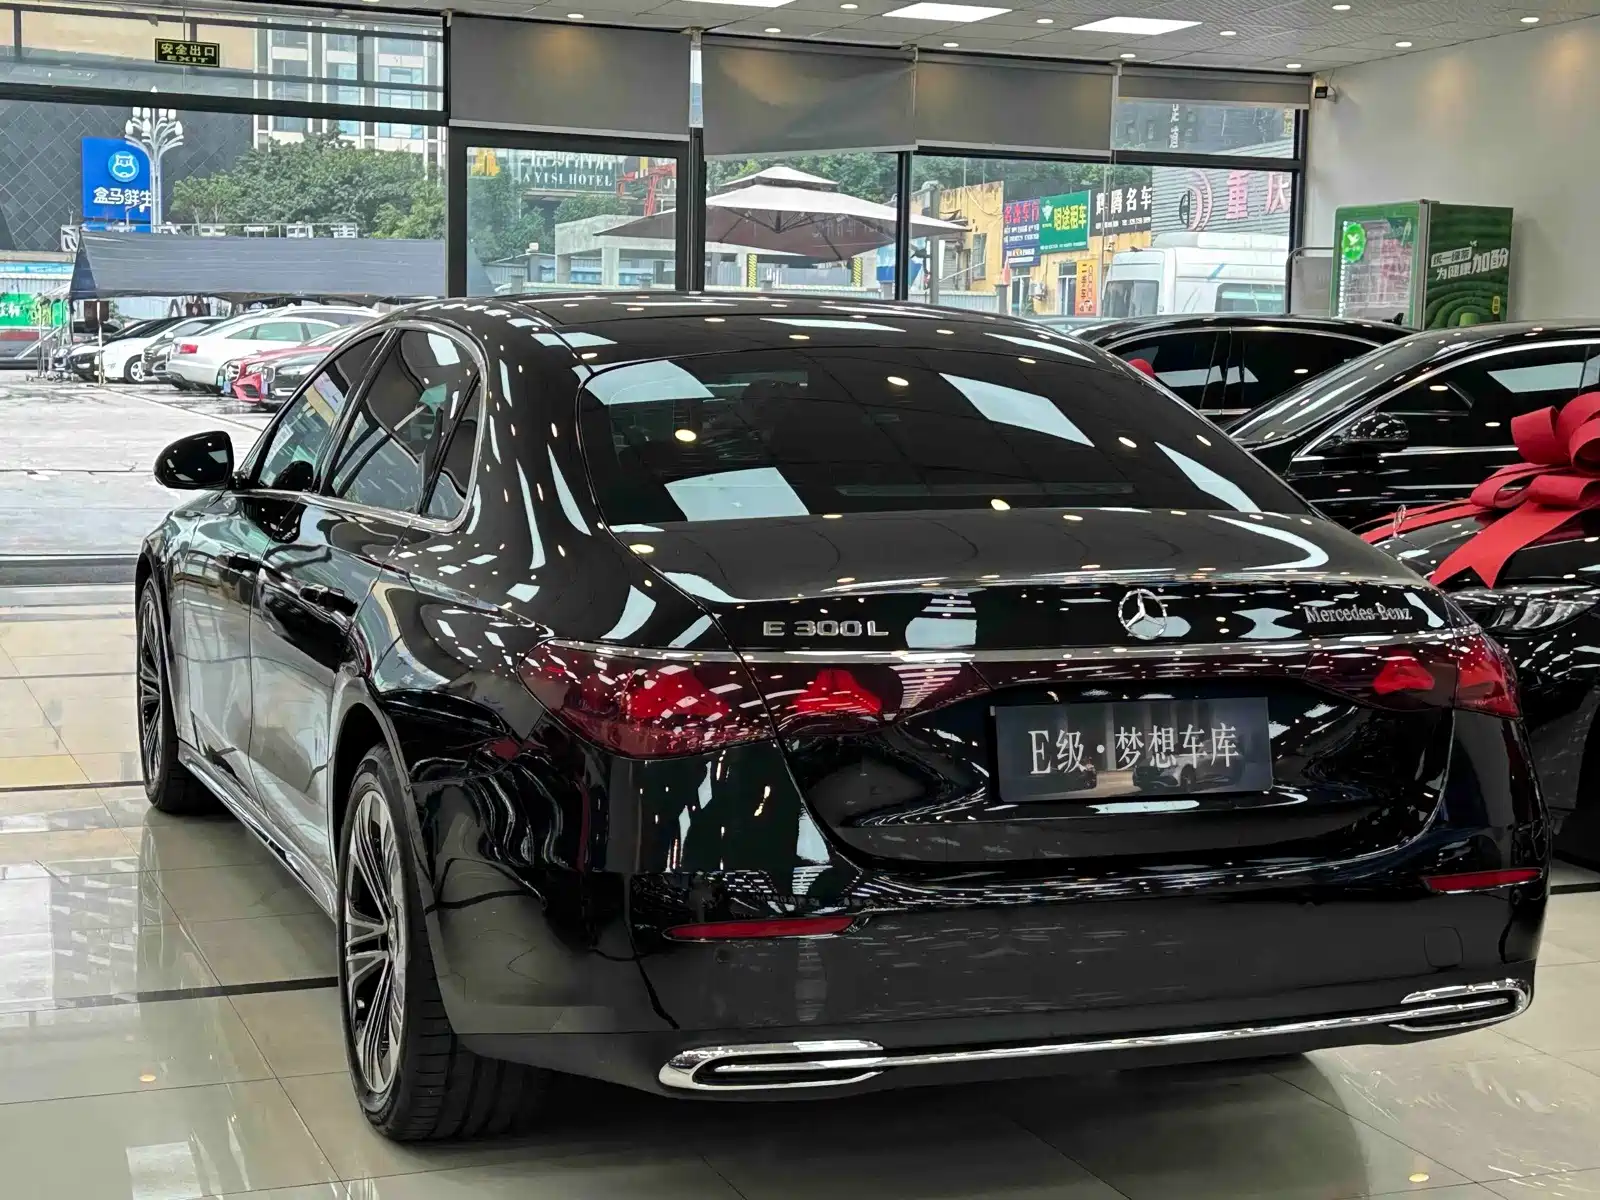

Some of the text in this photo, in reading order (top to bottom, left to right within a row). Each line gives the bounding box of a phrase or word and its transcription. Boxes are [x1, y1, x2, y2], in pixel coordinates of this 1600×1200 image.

[161, 43, 214, 57] 安全出口
[166, 55, 208, 63] EXIT
[569, 174, 613, 187] HOTEL
[93, 187, 151, 210] 盒马鲜生
[1303, 604, 1413, 624] Mercedes-Benz
[763, 621, 785, 636] E
